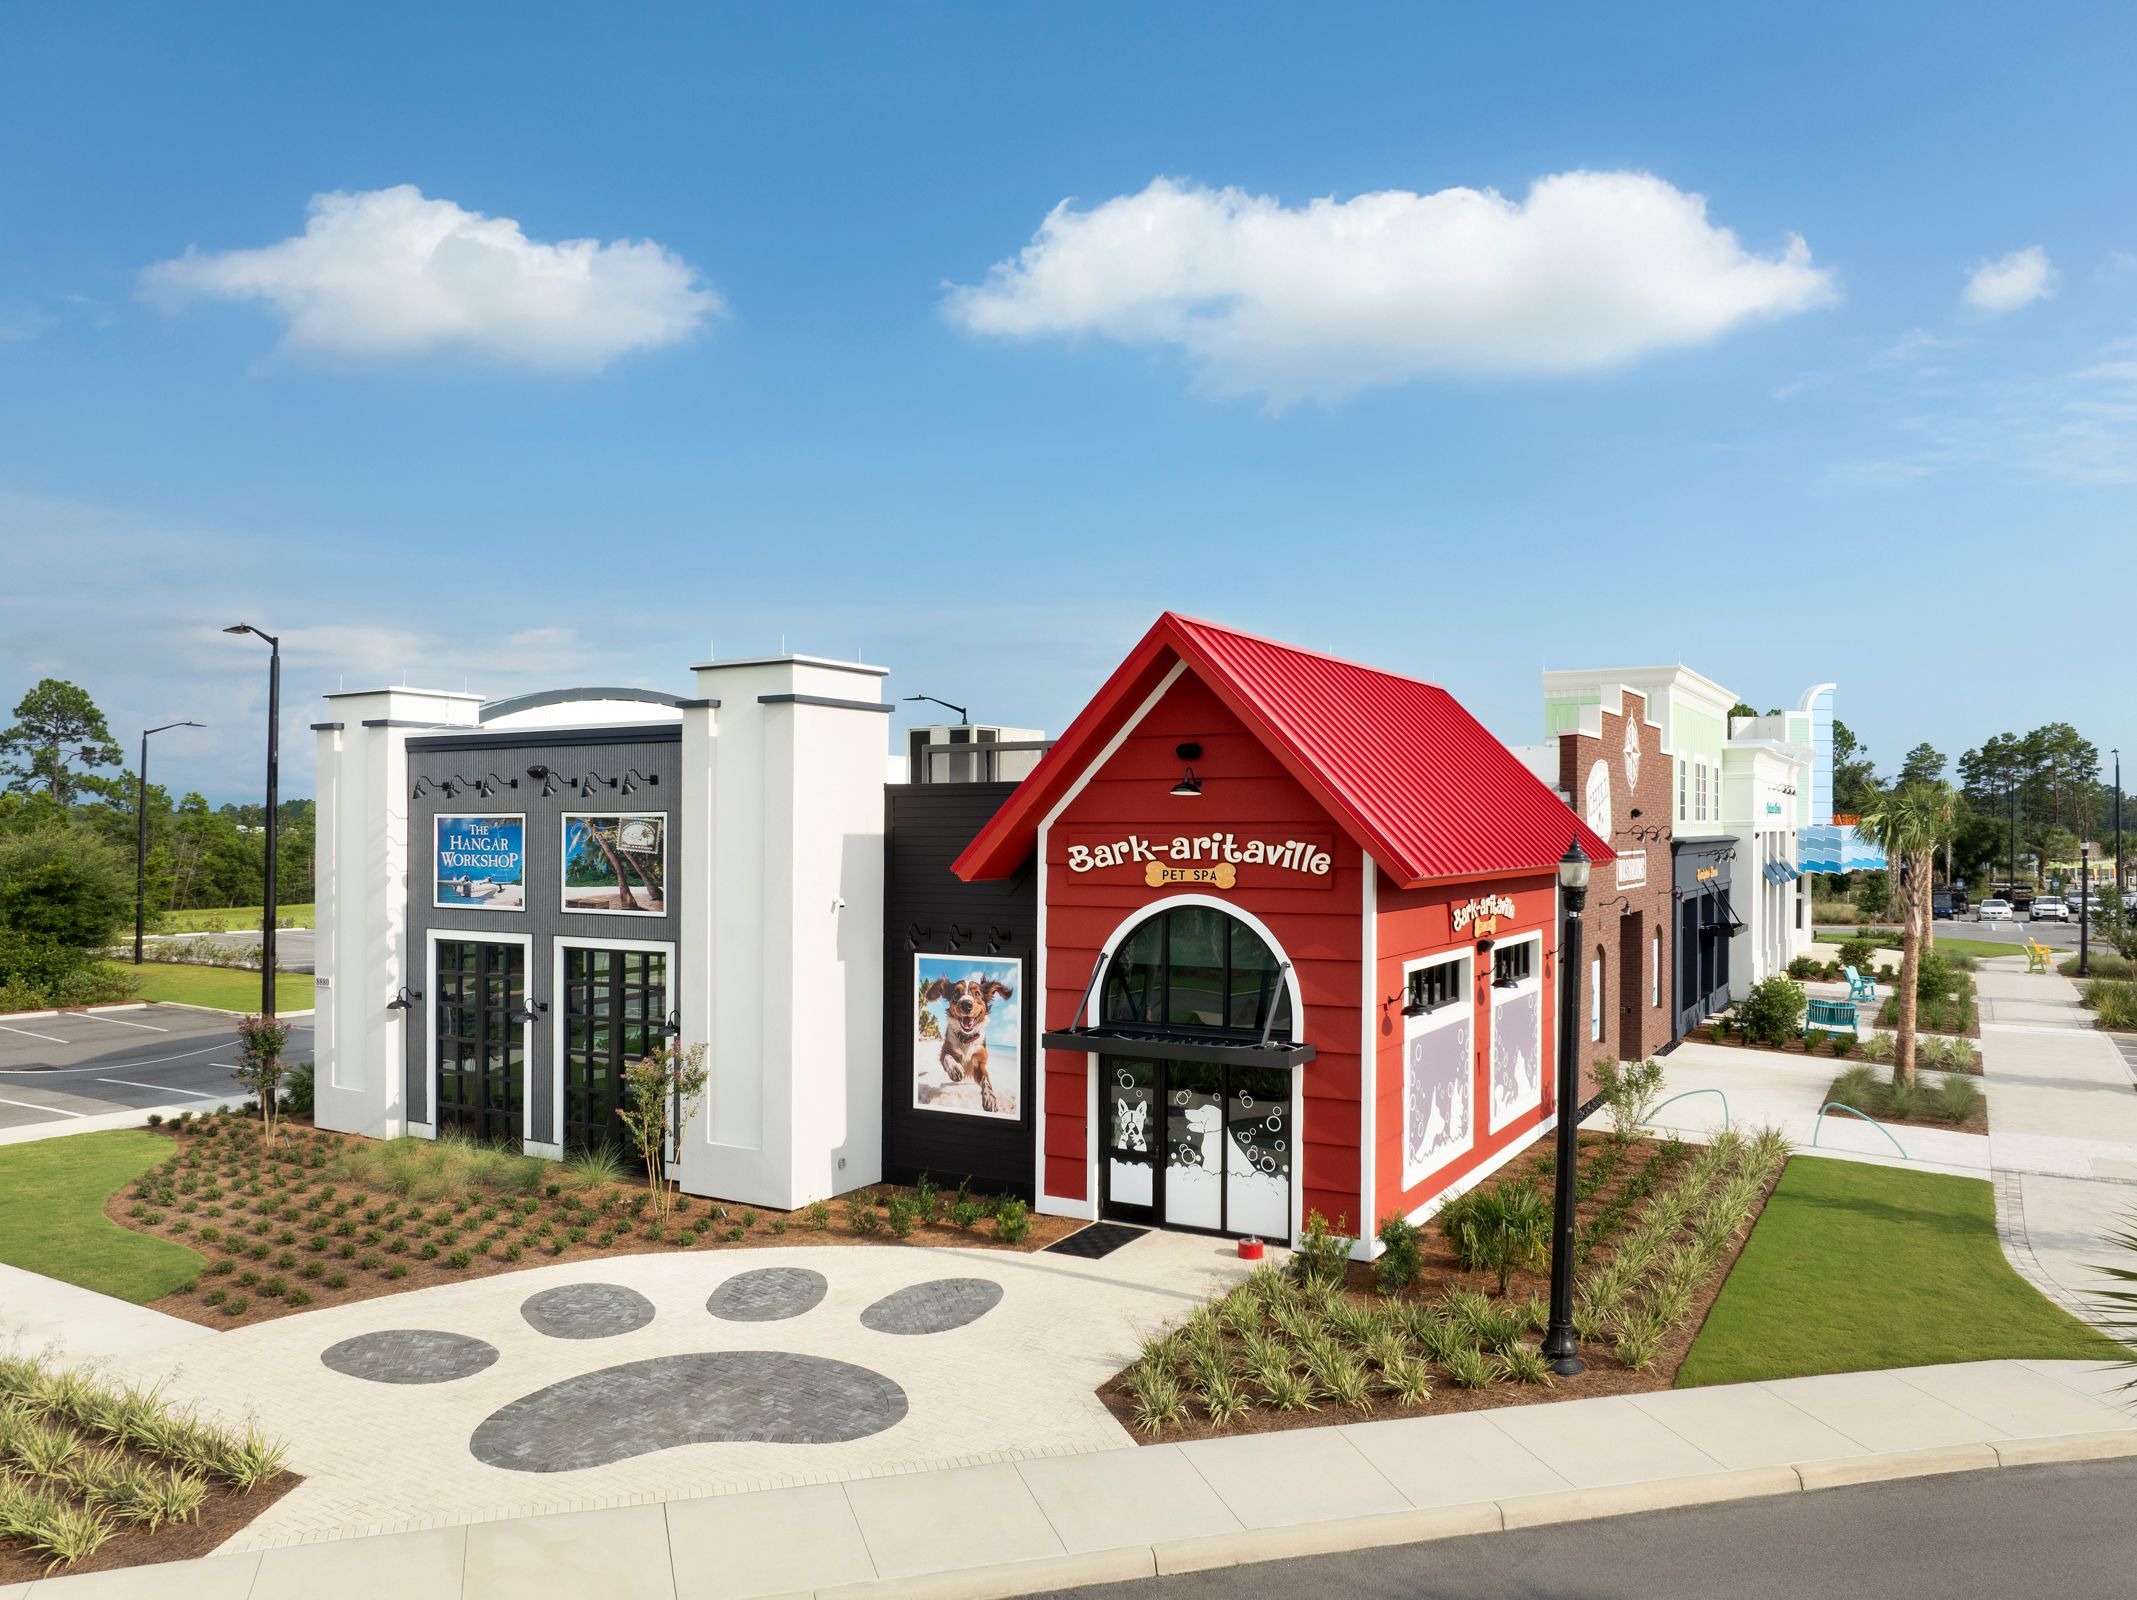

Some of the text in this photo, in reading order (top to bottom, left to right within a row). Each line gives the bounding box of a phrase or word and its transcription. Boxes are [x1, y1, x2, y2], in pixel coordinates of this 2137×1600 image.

[468, 824, 490, 836] THE
[450, 835, 509, 852] HANGAR
[440, 851, 519, 869] WORKSHOP
[1067, 832, 1332, 876] Bark-aritaville
[1162, 869, 1218, 881] PET SPA
